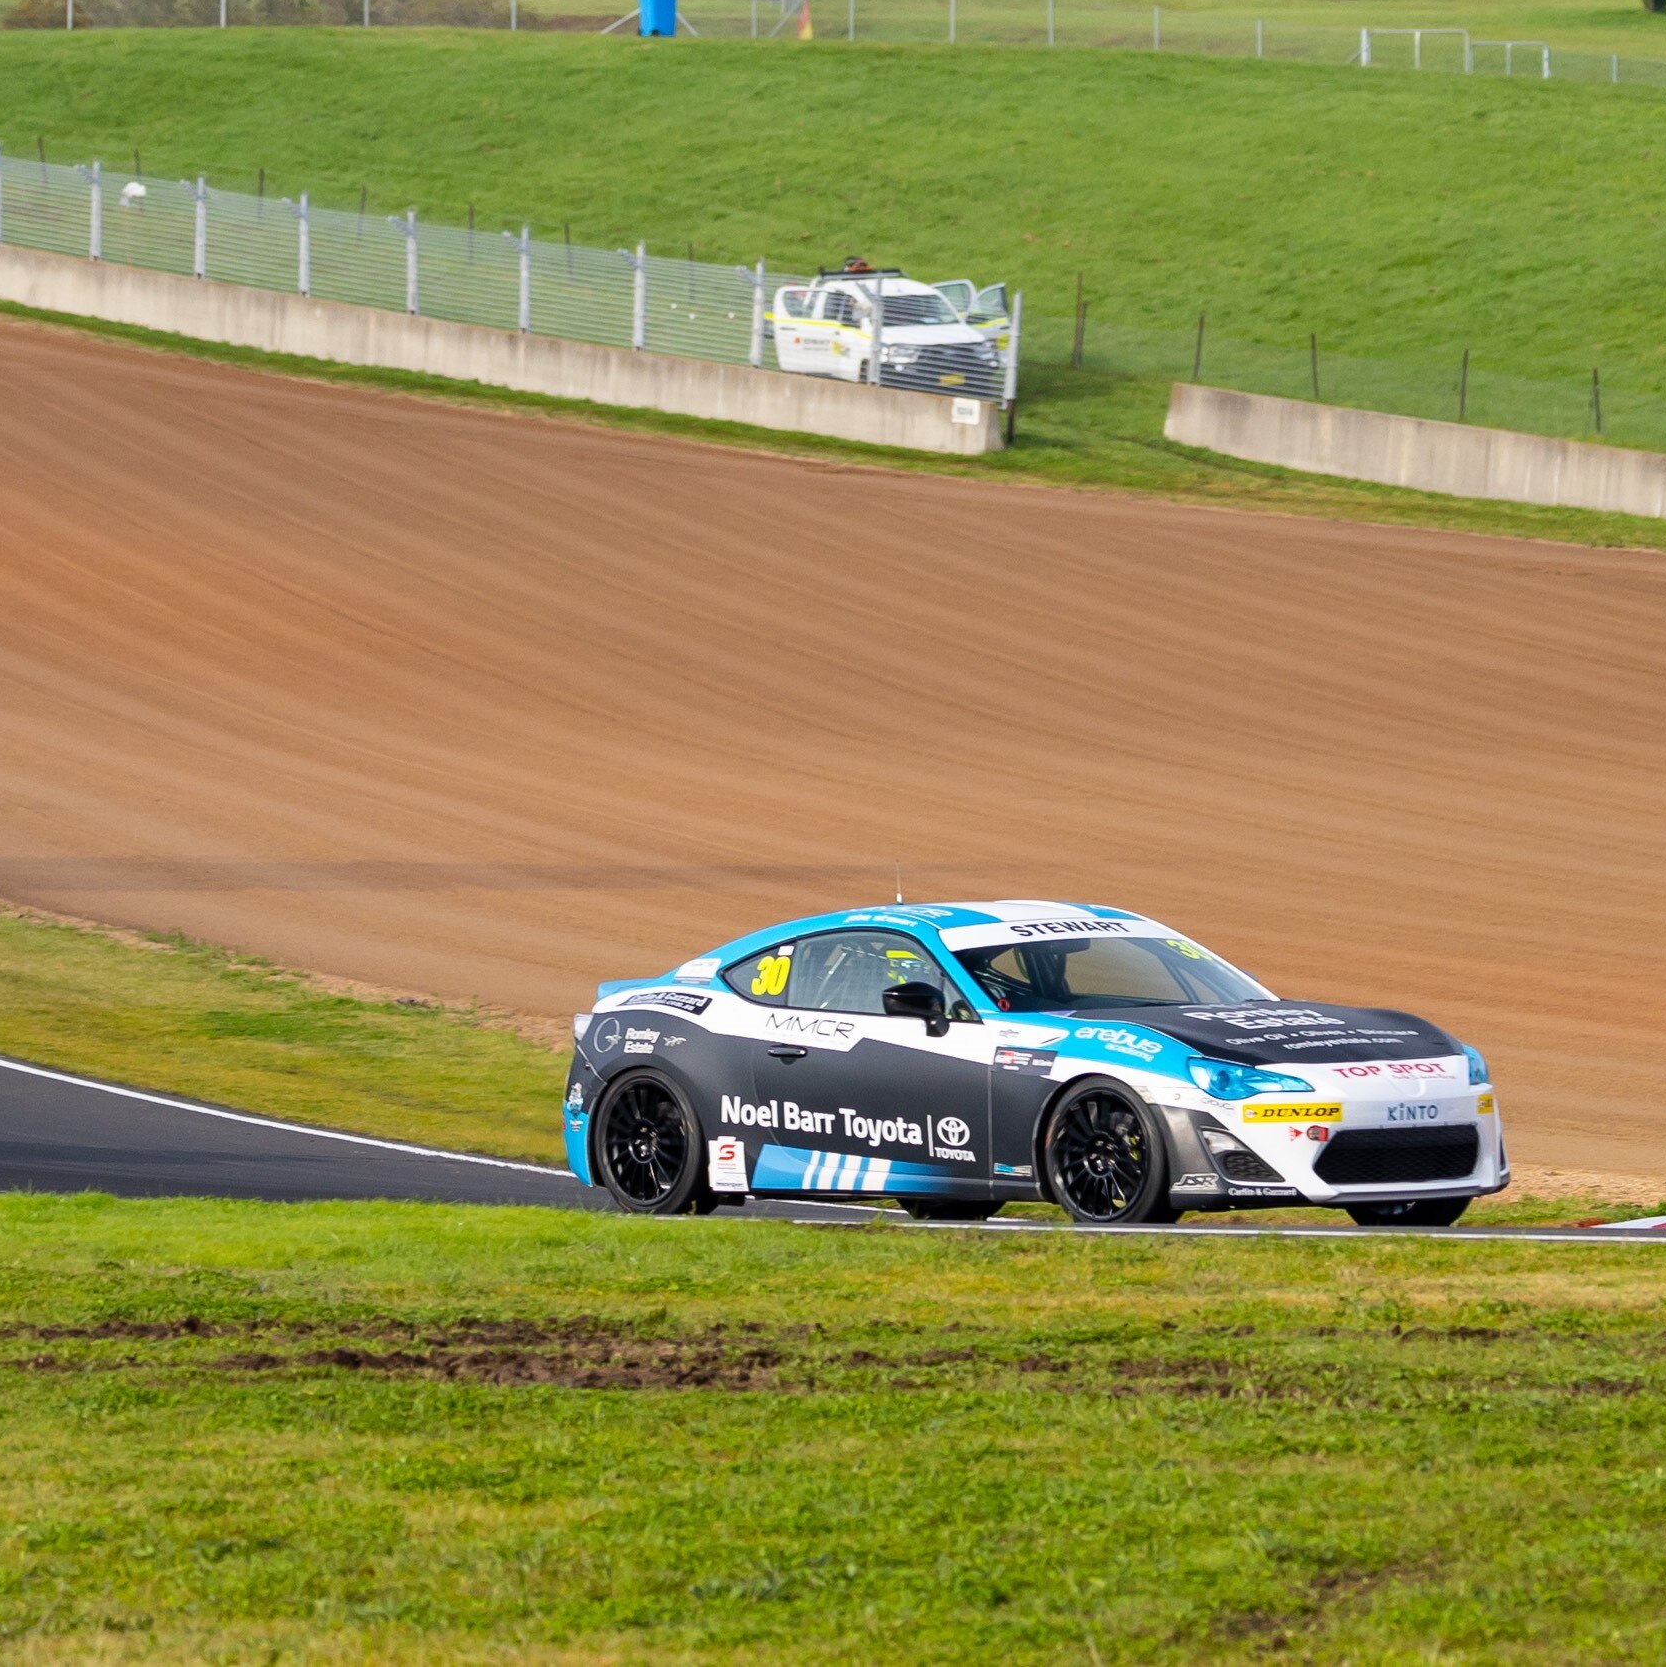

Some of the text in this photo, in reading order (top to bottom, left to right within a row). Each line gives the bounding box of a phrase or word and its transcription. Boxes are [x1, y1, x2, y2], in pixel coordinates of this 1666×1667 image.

[1010, 920, 1130, 937] STEWART
[751, 955, 791, 996] 30
[1183, 1008, 1323, 1021] Romley
[1224, 1015, 1346, 1029] Estate
[765, 1013, 855, 1039] MMCR
[624, 1027, 660, 1043] Romley
[1225, 1036, 1263, 1045] Olive
[1263, 1033, 1289, 1041] Oil
[1299, 1029, 1342, 1037] Olives
[623, 1041, 654, 1054] Estate
[1283, 1037, 1405, 1050] romleyestate.com
[1333, 1065, 1381, 1078] TOP
[1387, 1063, 1446, 1075] SPOT
[720, 1094, 923, 1146] Noel Barr Toyota
[1261, 1107, 1341, 1118] DUNLOP
[934, 1146, 976, 1162] TOYOTA
